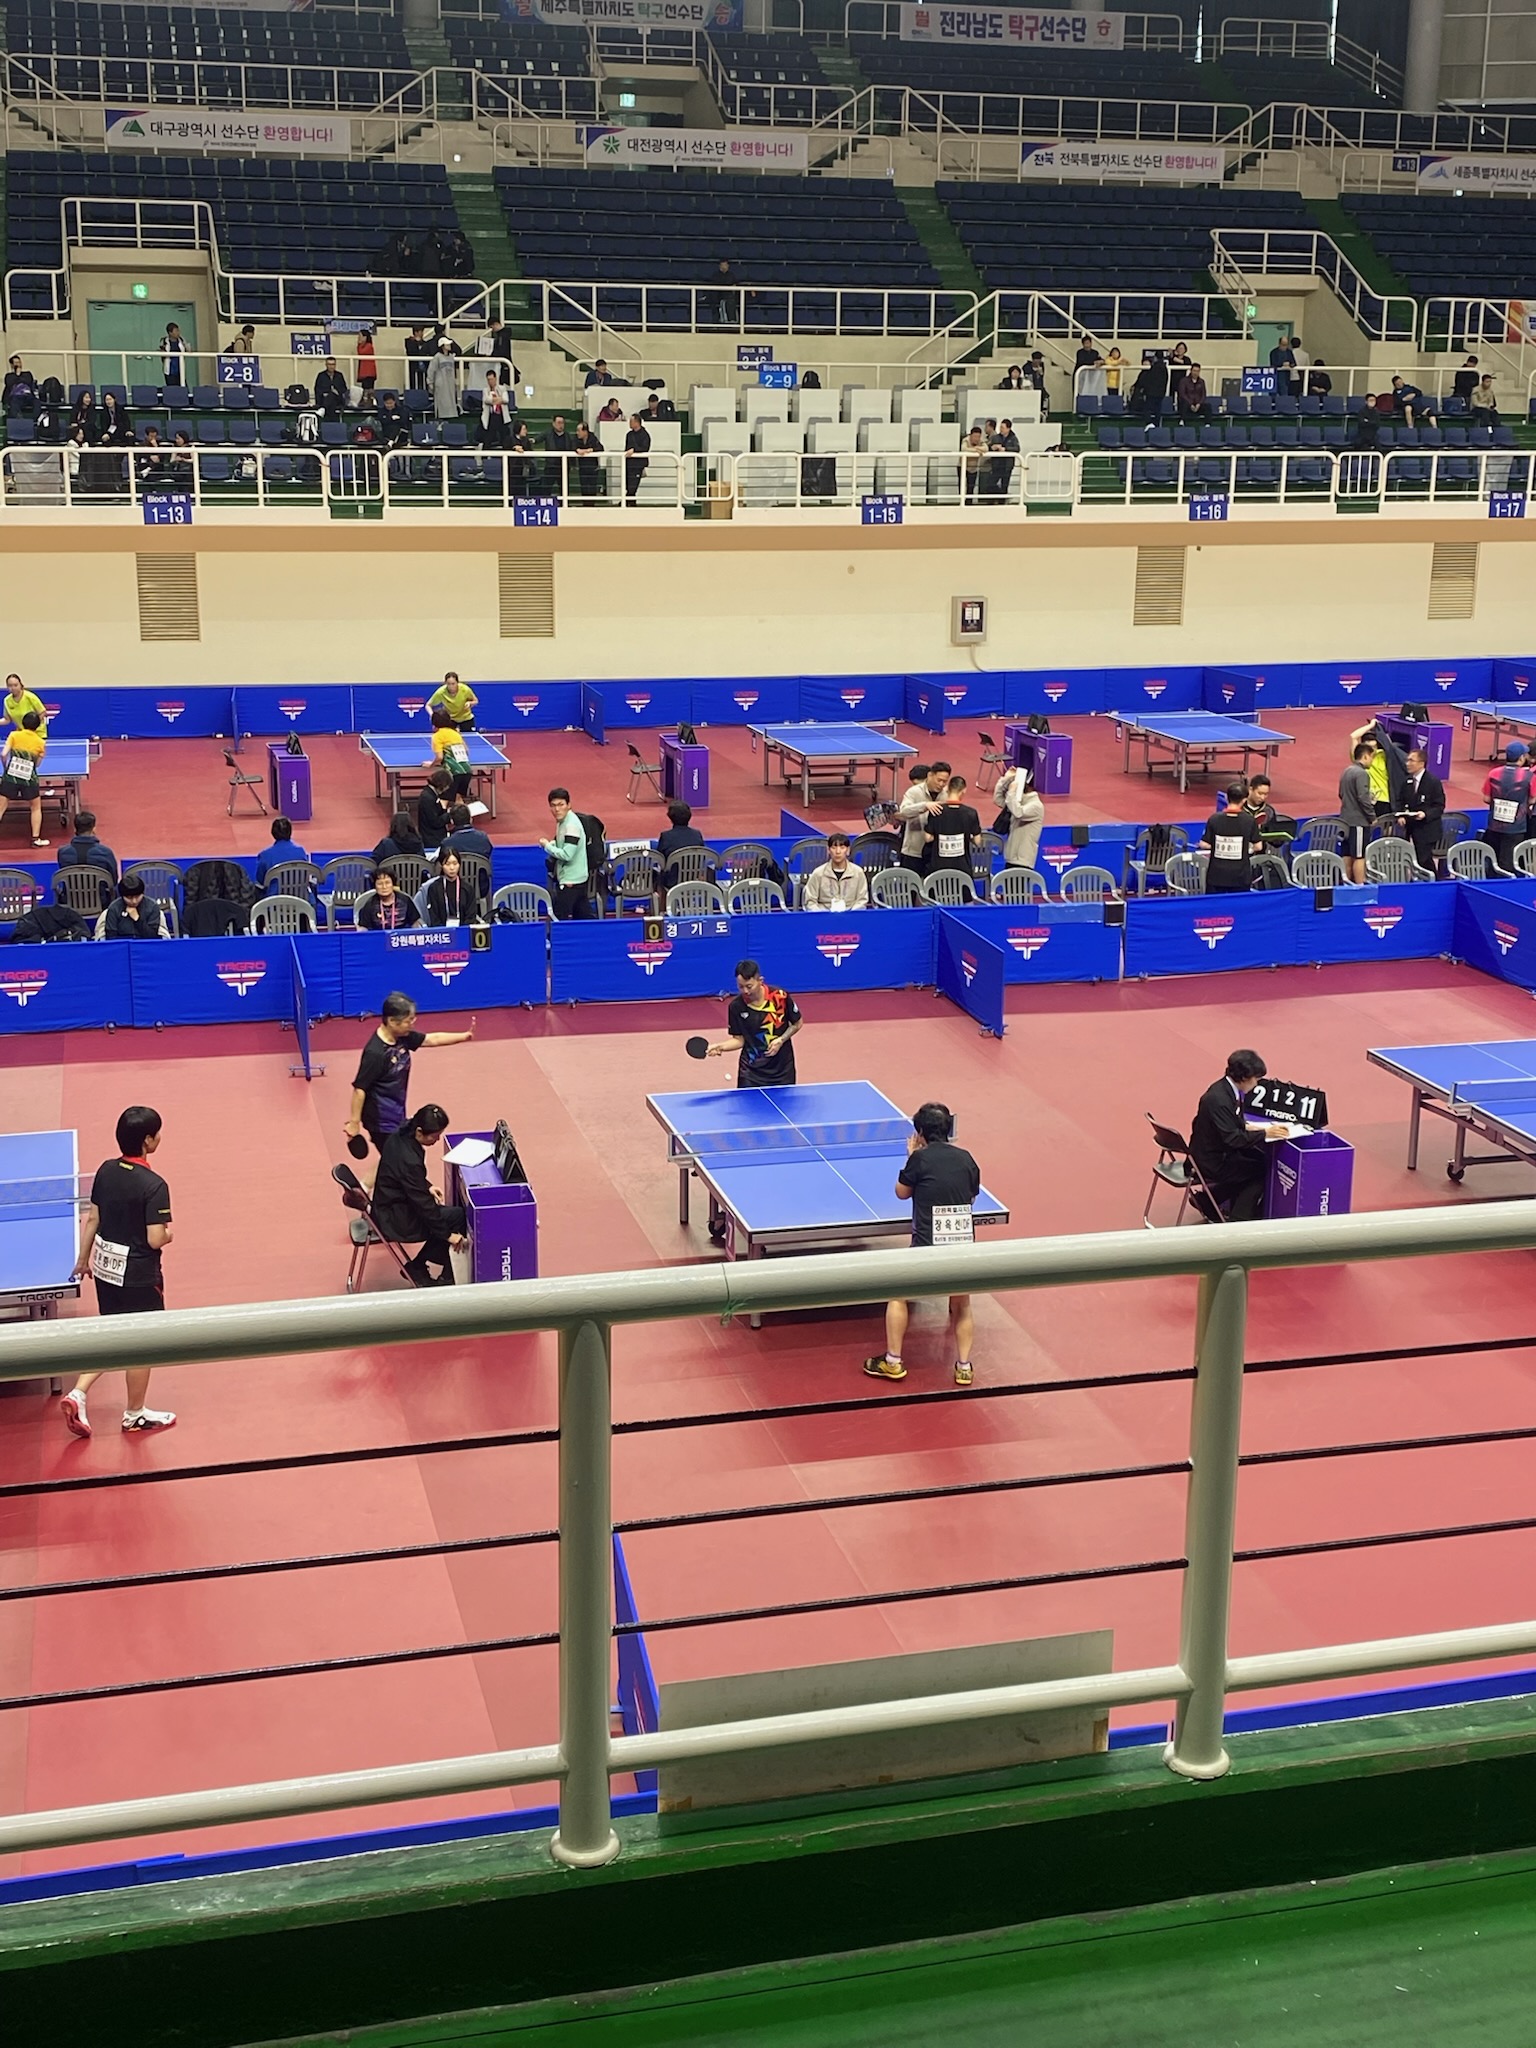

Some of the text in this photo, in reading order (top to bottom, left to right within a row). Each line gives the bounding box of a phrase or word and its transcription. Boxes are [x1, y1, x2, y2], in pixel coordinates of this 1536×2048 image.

[915, 10, 930, 28] 필
[939, 11, 1003, 38] 전라남도
[1008, 14, 1087, 42] 탁구선수단
[1097, 19, 1111, 36] 승
[150, 121, 333, 142] 대구광역시 선수단 환영합니다!
[627, 138, 794, 156] 대전광역시 선수단 환영합니다!
[1034, 152, 1054, 166] 전북
[1060, 153, 1217, 169] 전북특별자치도 선수단 환영합니다!
[1397, 159, 1416, 171] 4-13
[1453, 165, 1518, 180] 세종특별자치시
[297, 344, 324, 355] 3-15
[224, 366, 253, 382] 2-8
[765, 374, 792, 388] 2-9
[1245, 377, 1274, 389] 2-10
[152, 506, 185, 523] 1-13
[521, 509, 551, 525] 1-14
[869, 507, 897, 523] 1-15
[1196, 504, 1222, 519] 1-16
[1495, 502, 1520, 517] 1-17
[649, 923, 659, 939] 0
[1007, 927, 1051, 937] TAGRO
[391, 933, 451, 948] 강원특별자치도
[474, 931, 486, 947] 0
[816, 934, 860, 944] TAGRO
[422, 952, 469, 962] TAGRO
[216, 960, 267, 971] TAGRO
[1251, 1085, 1317, 1120] 2 1 2 11
[1265, 1108, 1298, 1122] TAGRO
[1320, 1187, 1330, 1216] TAGR
[501, 1246, 511, 1281] TAGR
[17, 1291, 64, 1302] TAGRO
